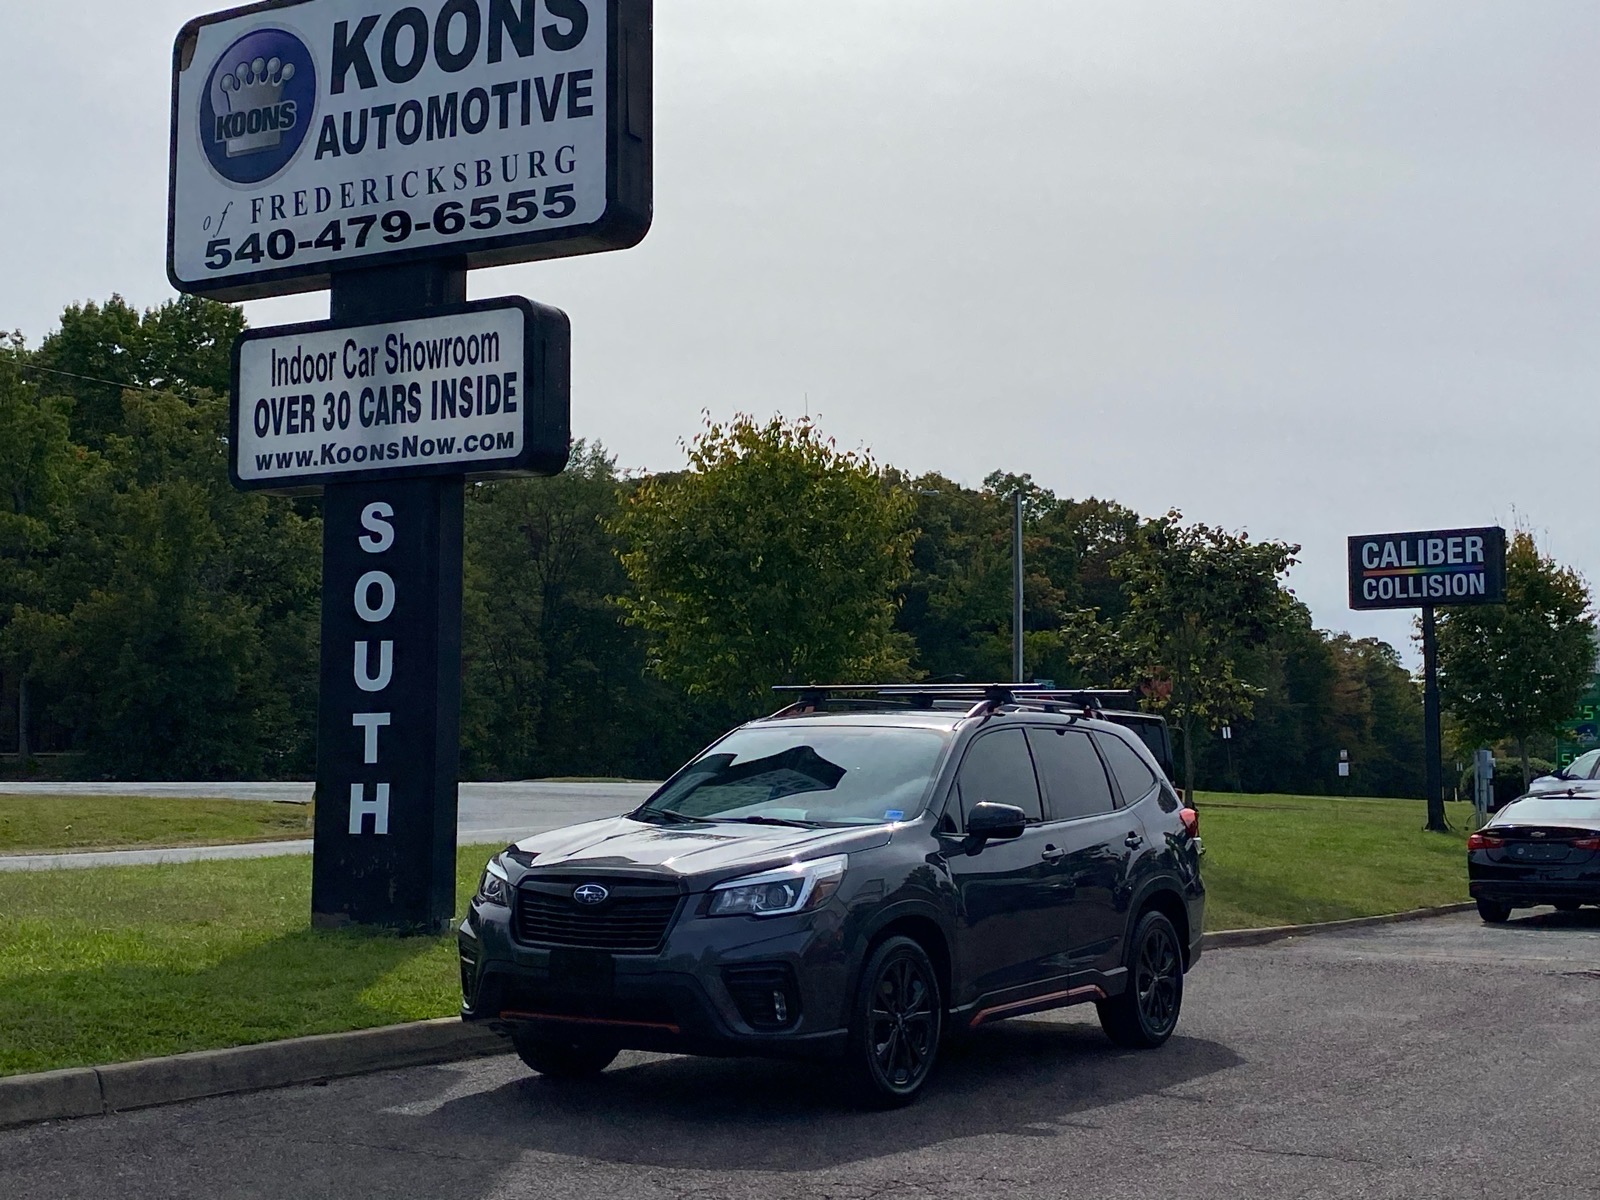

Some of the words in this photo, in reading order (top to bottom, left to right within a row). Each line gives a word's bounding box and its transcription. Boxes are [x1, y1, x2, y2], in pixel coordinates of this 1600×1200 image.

[215, 101, 297, 142] KOONS
[314, 69, 595, 161] AUTOMOTIVE
[202, 201, 234, 238] of
[251, 145, 577, 224] FREDERICKSBURG
[204, 183, 577, 271] 540-479-6555
[271, 345, 337, 388] Indoor
[343, 338, 379, 378] Car
[385, 331, 500, 375] Showroom
[254, 394, 315, 438] OVER
[322, 391, 351, 432] 30
[359, 381, 422, 428] CARS
[431, 371, 518, 421] INSIDE
[1361, 535, 1485, 569] CALIBER
[1362, 572, 1486, 600] COLLISION
[348, 501, 396, 835] SOUTH
